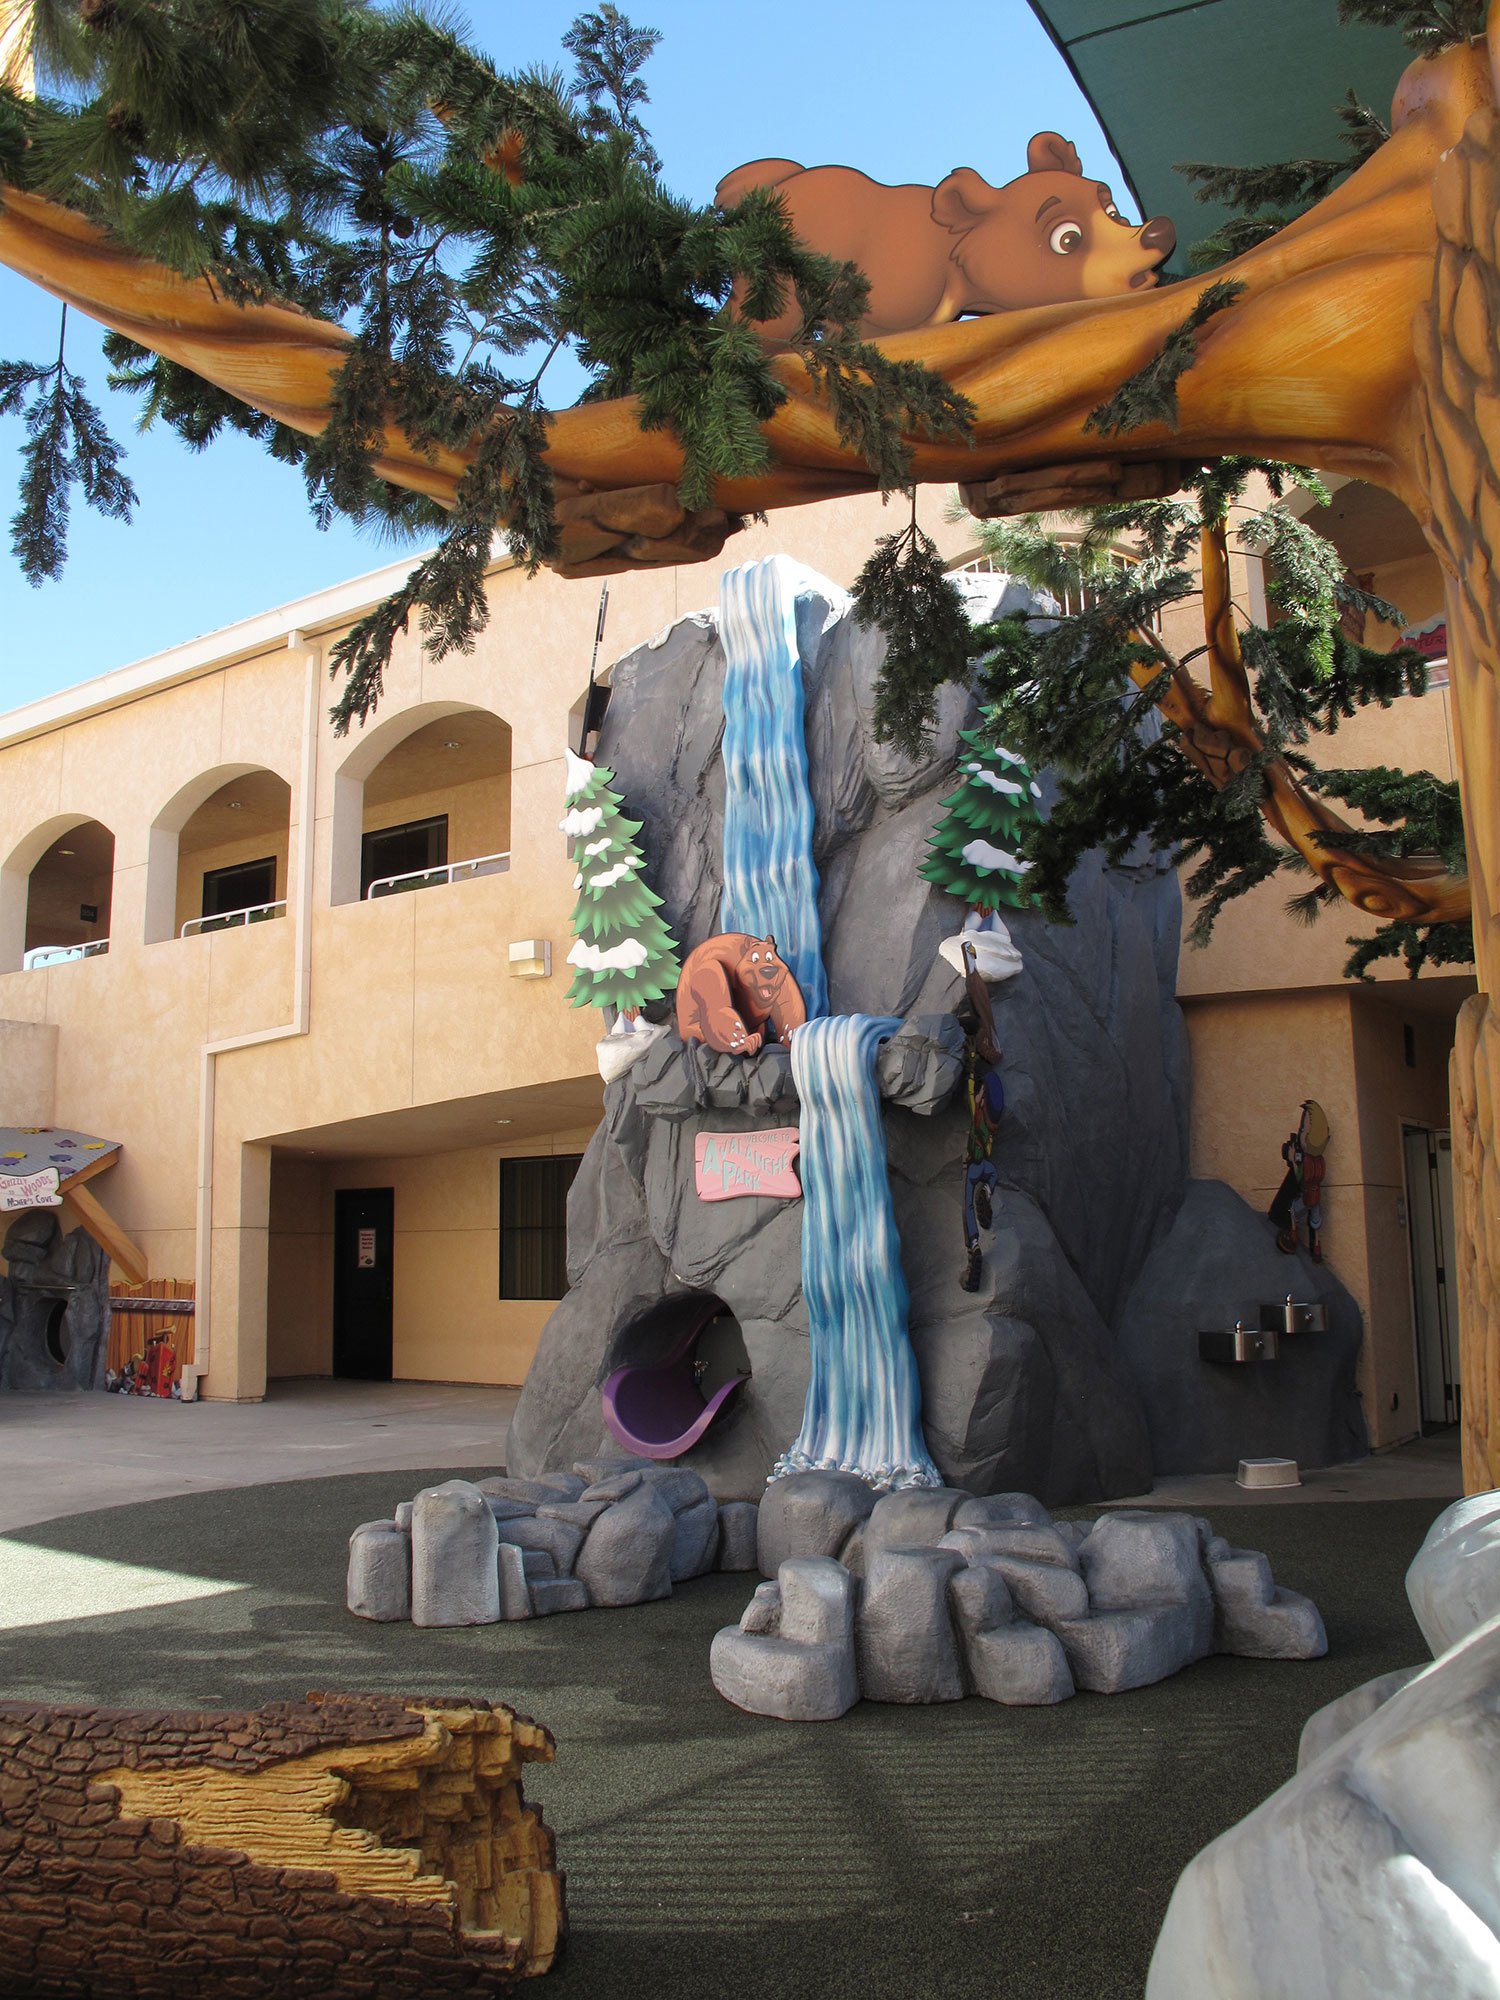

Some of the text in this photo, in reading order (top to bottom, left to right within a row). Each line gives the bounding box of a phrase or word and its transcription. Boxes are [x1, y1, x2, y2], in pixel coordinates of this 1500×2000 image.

[745, 1133, 791, 1143] WELCOME TO
[702, 1137, 788, 1177] AVALANCHE
[722, 1159, 761, 1193] PARK
[35, 1194, 53, 1204] COVE
